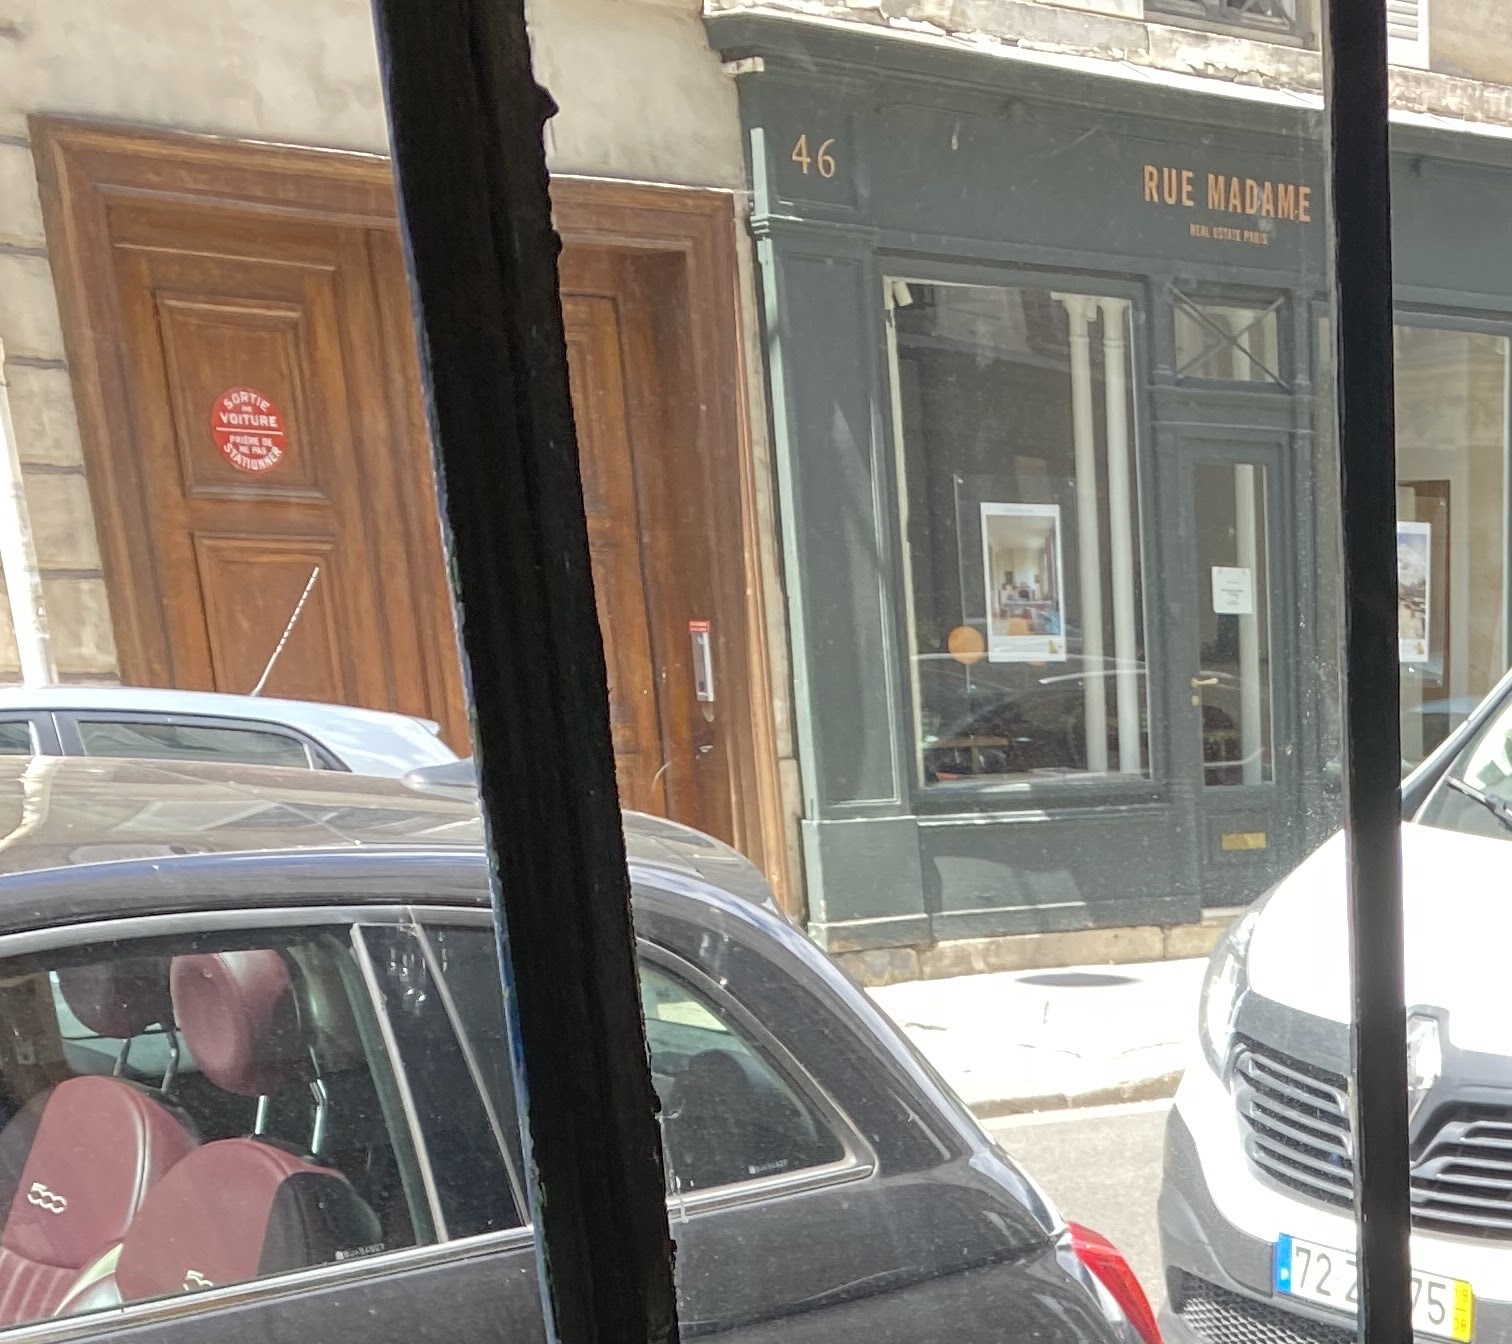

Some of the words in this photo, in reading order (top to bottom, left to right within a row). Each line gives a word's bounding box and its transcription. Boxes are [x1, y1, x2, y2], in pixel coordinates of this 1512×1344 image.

[792, 134, 836, 180] 46
[1144, 165, 1194, 207] RUE
[1208, 173, 1311, 223] MADAME
[223, 391, 271, 412] SORTIE
[219, 412, 278, 428] VOITURE
[223, 443, 283, 470] STATIONNER
[27, 1182, 67, 1214] 500
[1296, 1246, 1332, 1296] 72
